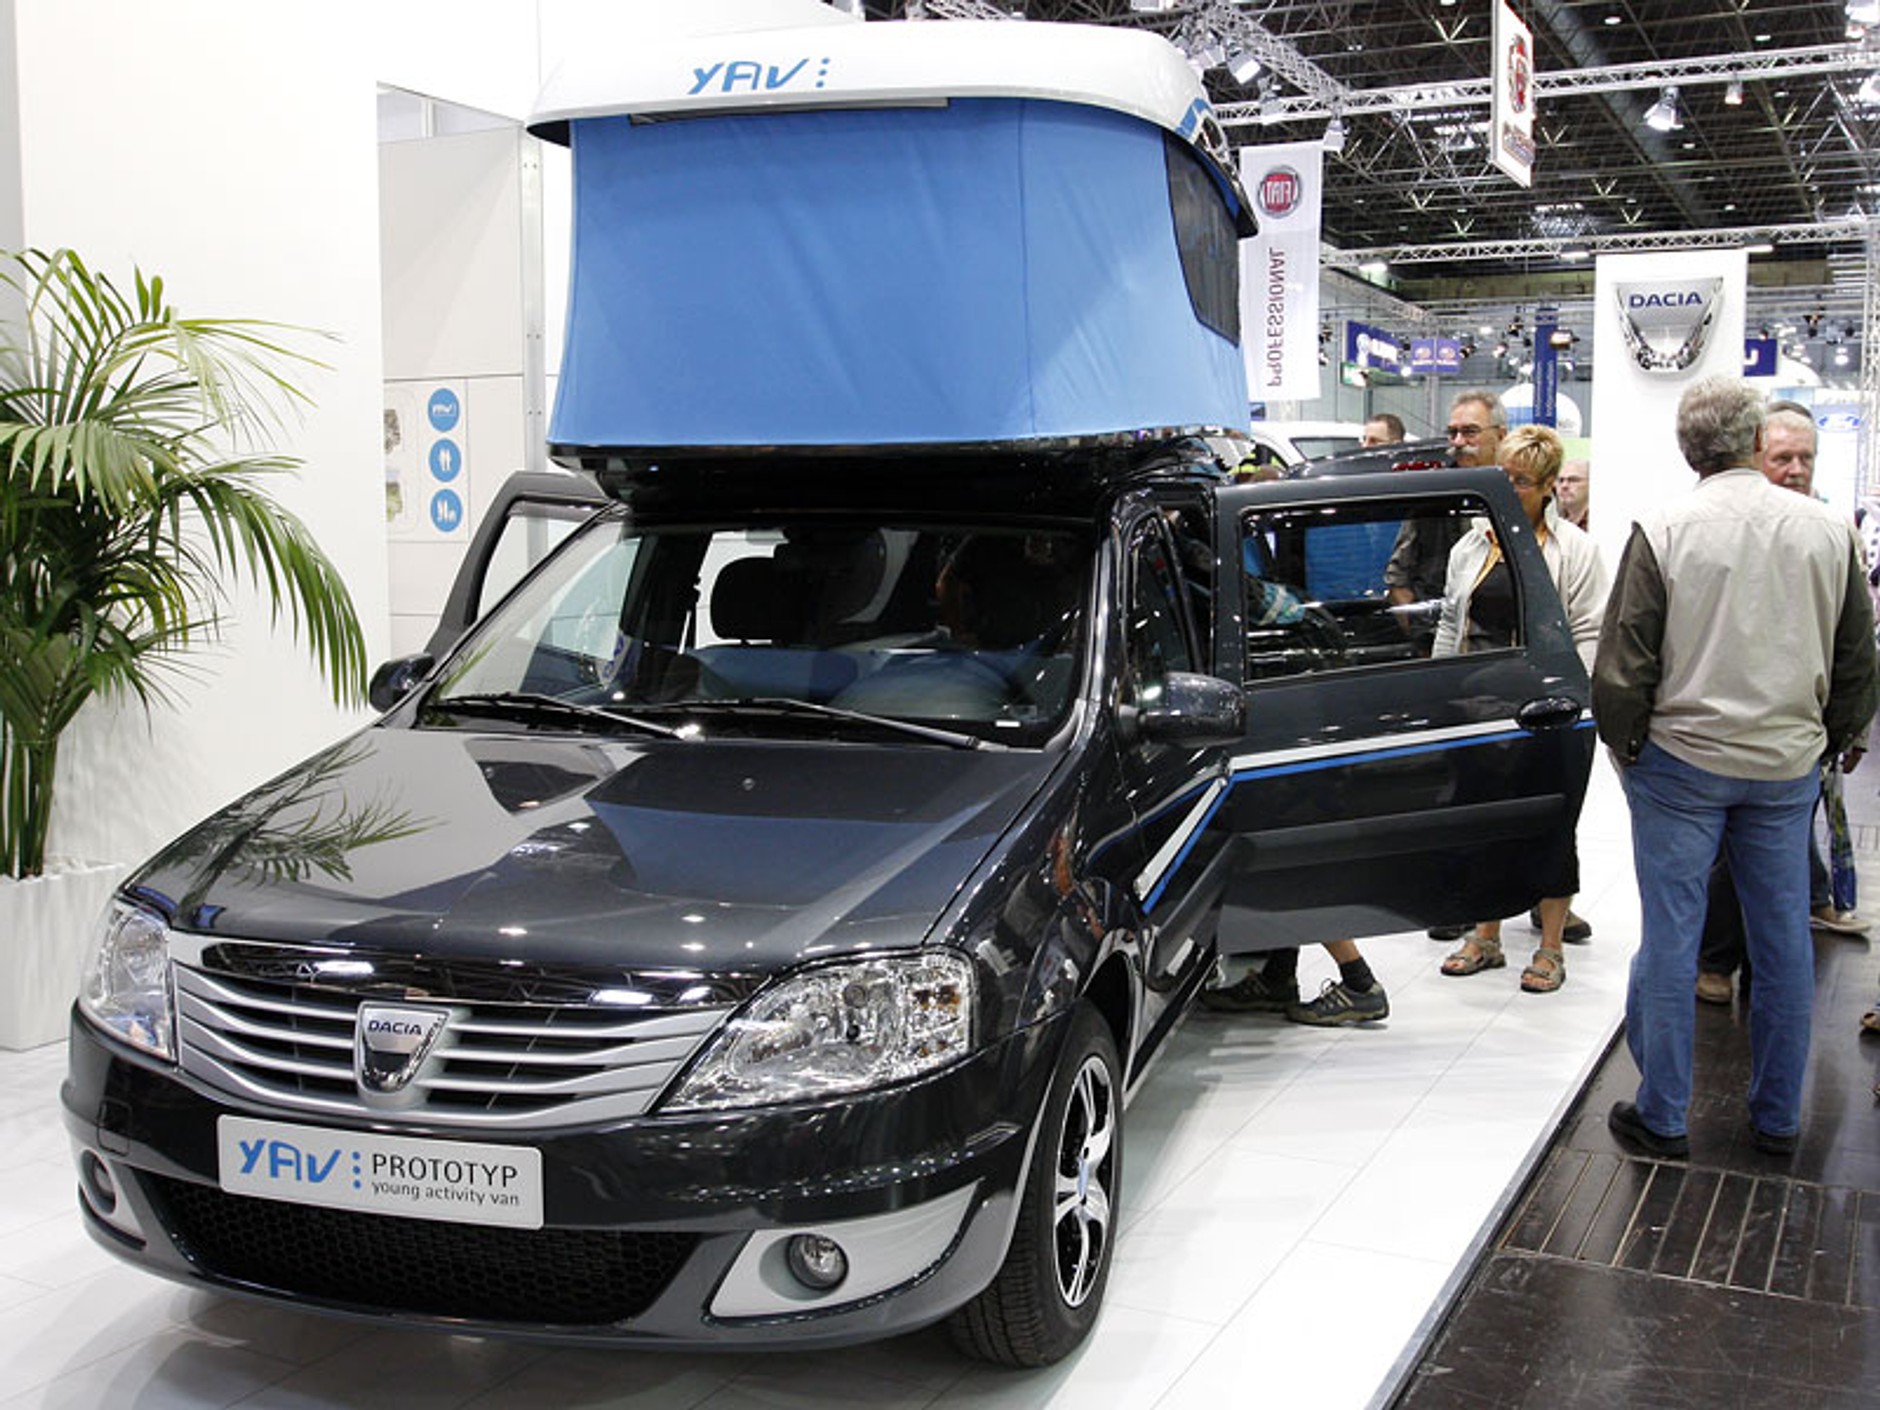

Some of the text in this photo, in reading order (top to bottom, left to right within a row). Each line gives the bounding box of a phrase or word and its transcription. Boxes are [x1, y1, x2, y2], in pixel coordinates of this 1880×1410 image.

[1629, 291, 1703, 308] DACIA
[368, 1020, 422, 1035] DACIA
[372, 1153, 517, 1188] PROTOTYP
[371, 1181, 520, 1206] young activity van
